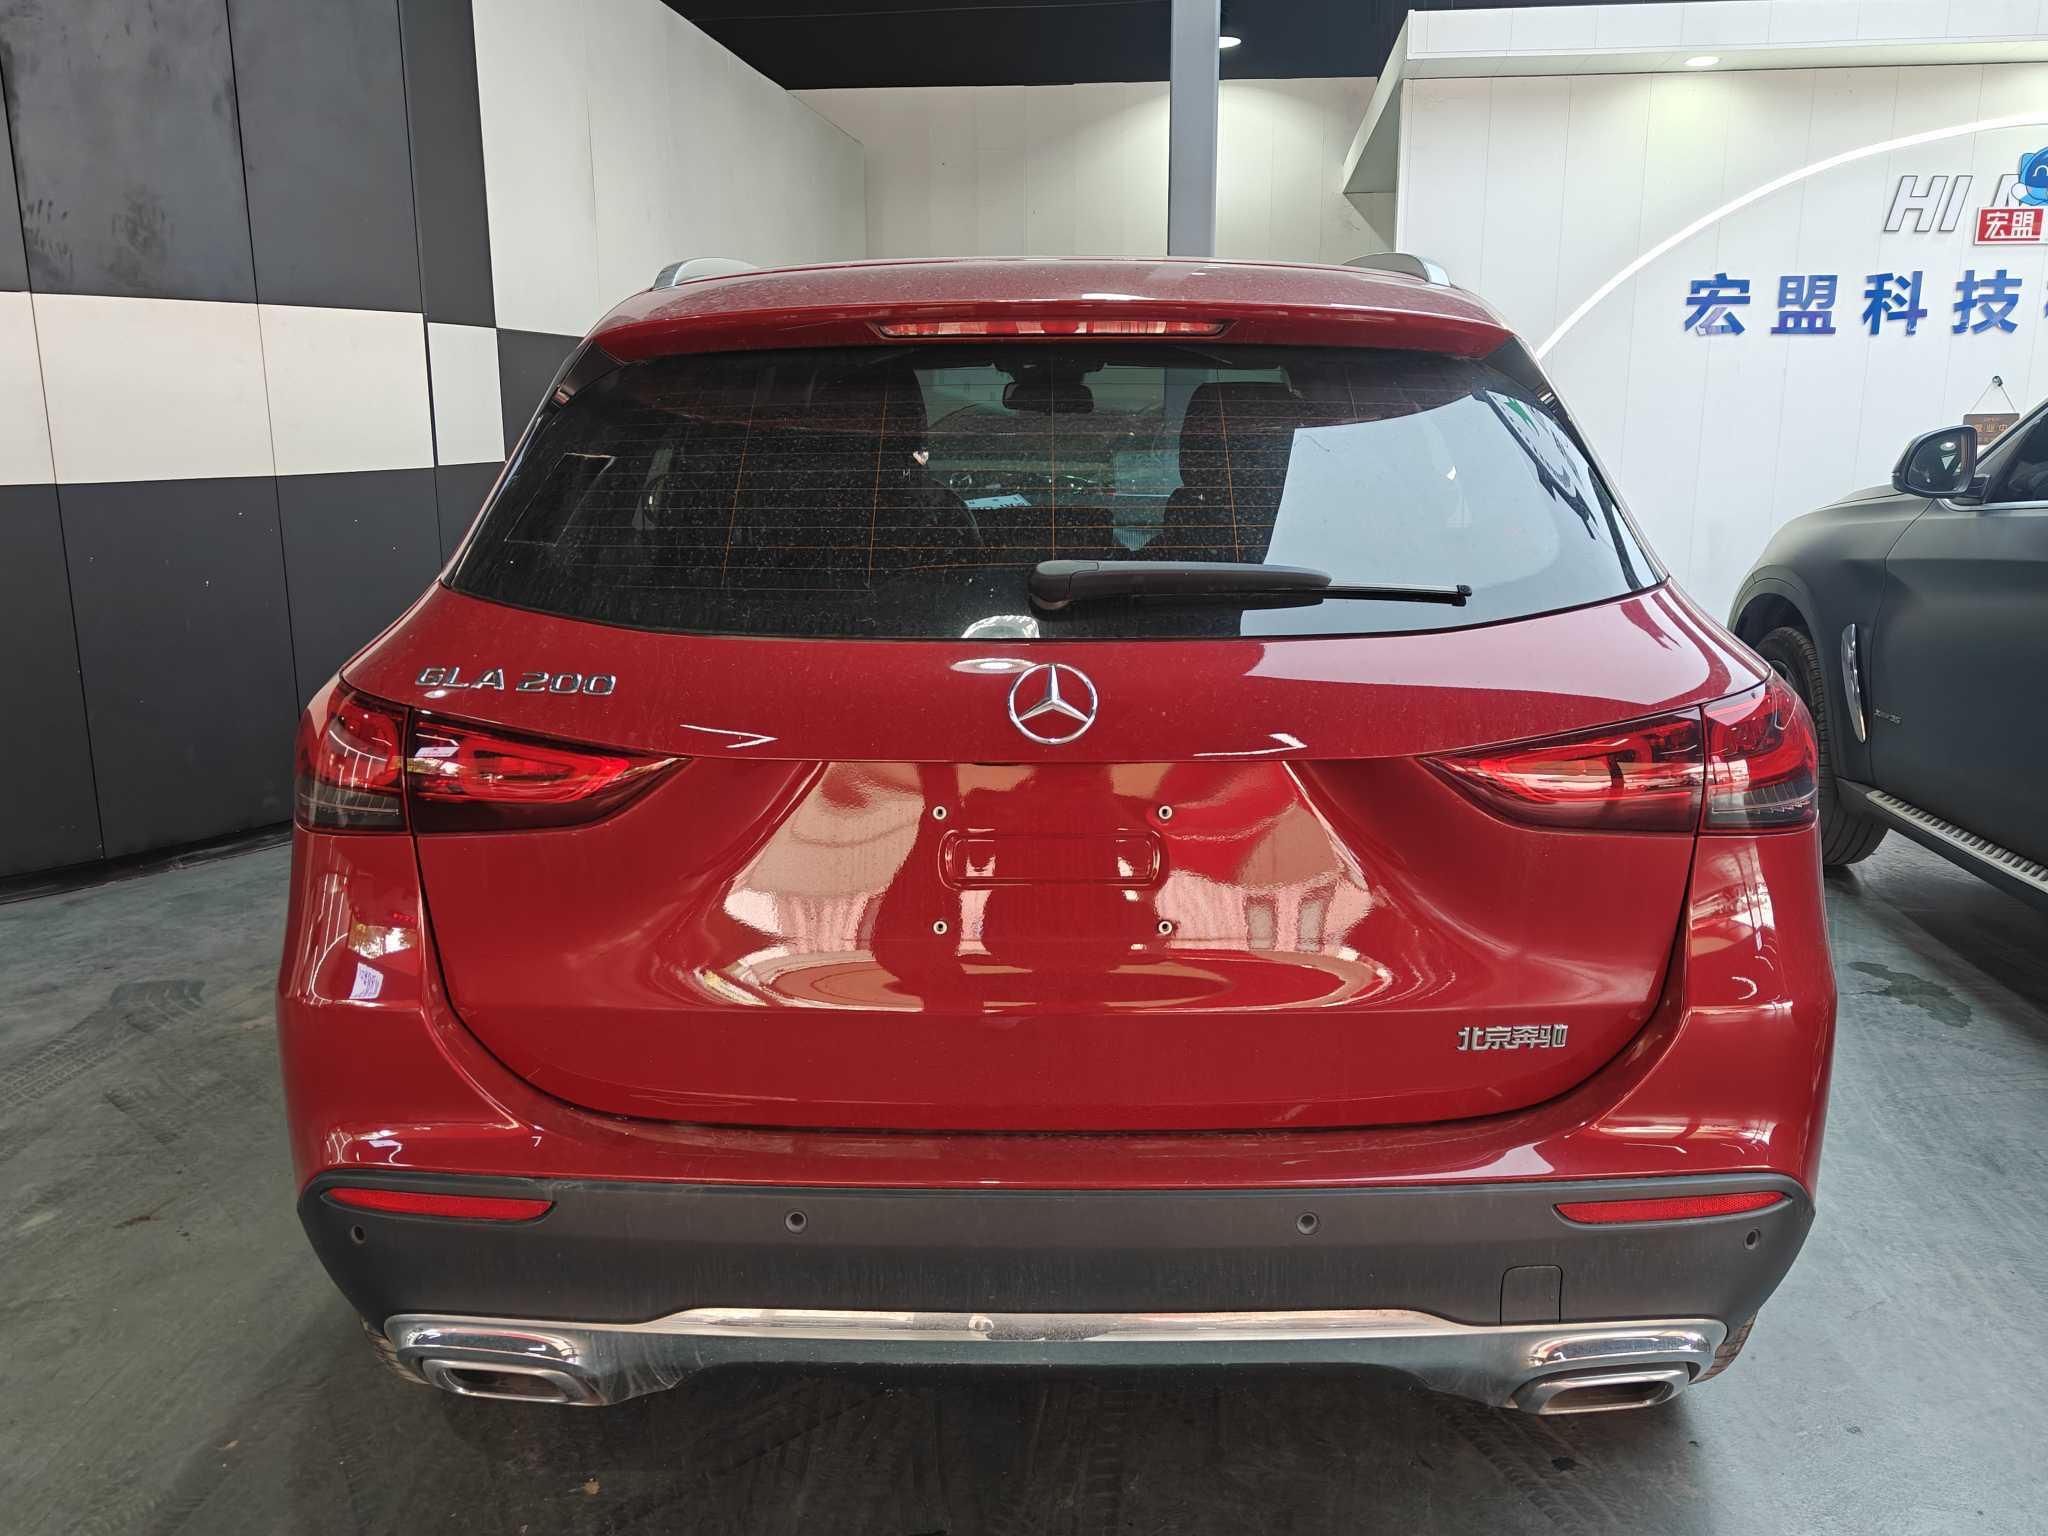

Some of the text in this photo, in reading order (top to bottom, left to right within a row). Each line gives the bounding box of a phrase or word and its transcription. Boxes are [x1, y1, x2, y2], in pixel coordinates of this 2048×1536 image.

[1984, 211, 2035, 240] 宏盟
[1684, 269, 2048, 336] 宏盟科技
[415, 667, 617, 696] GLA 200
[1456, 1023, 1569, 1051] 北京奔驰
